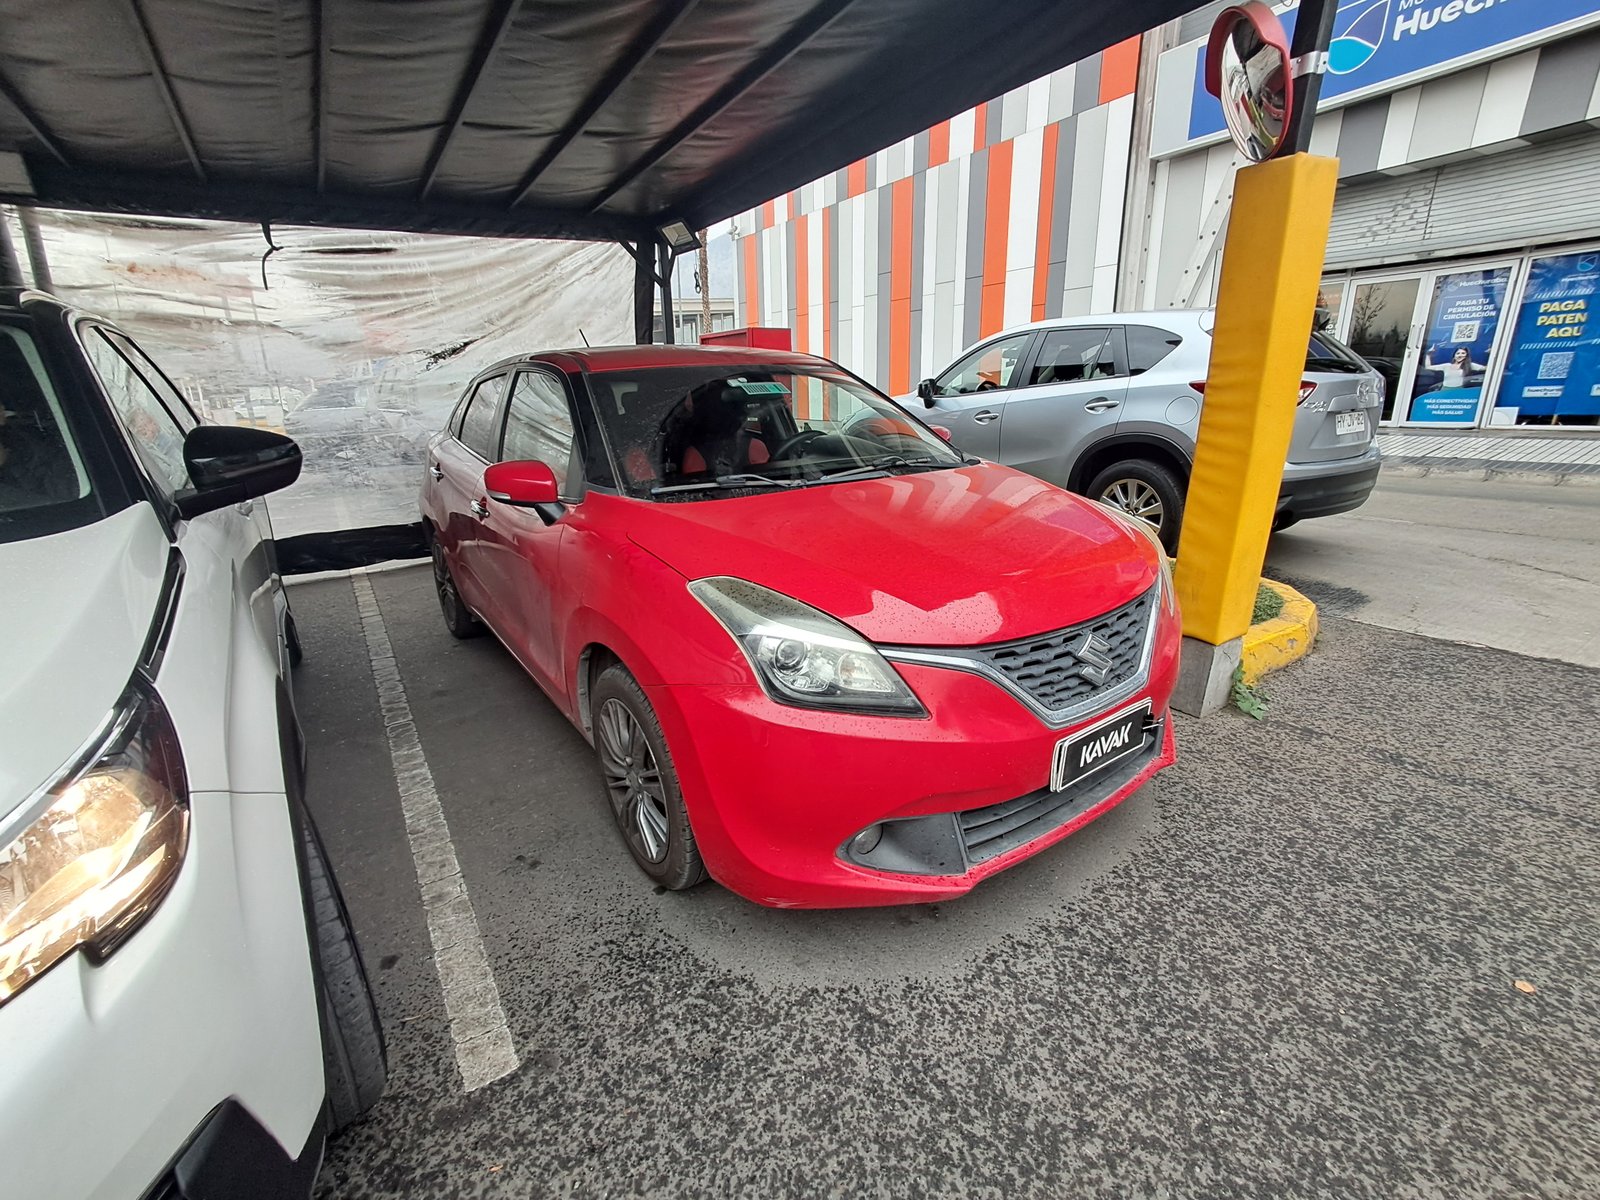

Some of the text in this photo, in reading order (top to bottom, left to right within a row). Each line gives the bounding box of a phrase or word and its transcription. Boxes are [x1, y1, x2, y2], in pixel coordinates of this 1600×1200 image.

[1447, 303, 1496, 314] PERMISO DE
[1455, 299, 1478, 307] PAGA
[1539, 299, 1586, 313] PAGA
[1442, 310, 1497, 320] CIRCULACIÓN
[1536, 312, 1588, 326] PATEN
[1079, 721, 1133, 768] KAVAK
